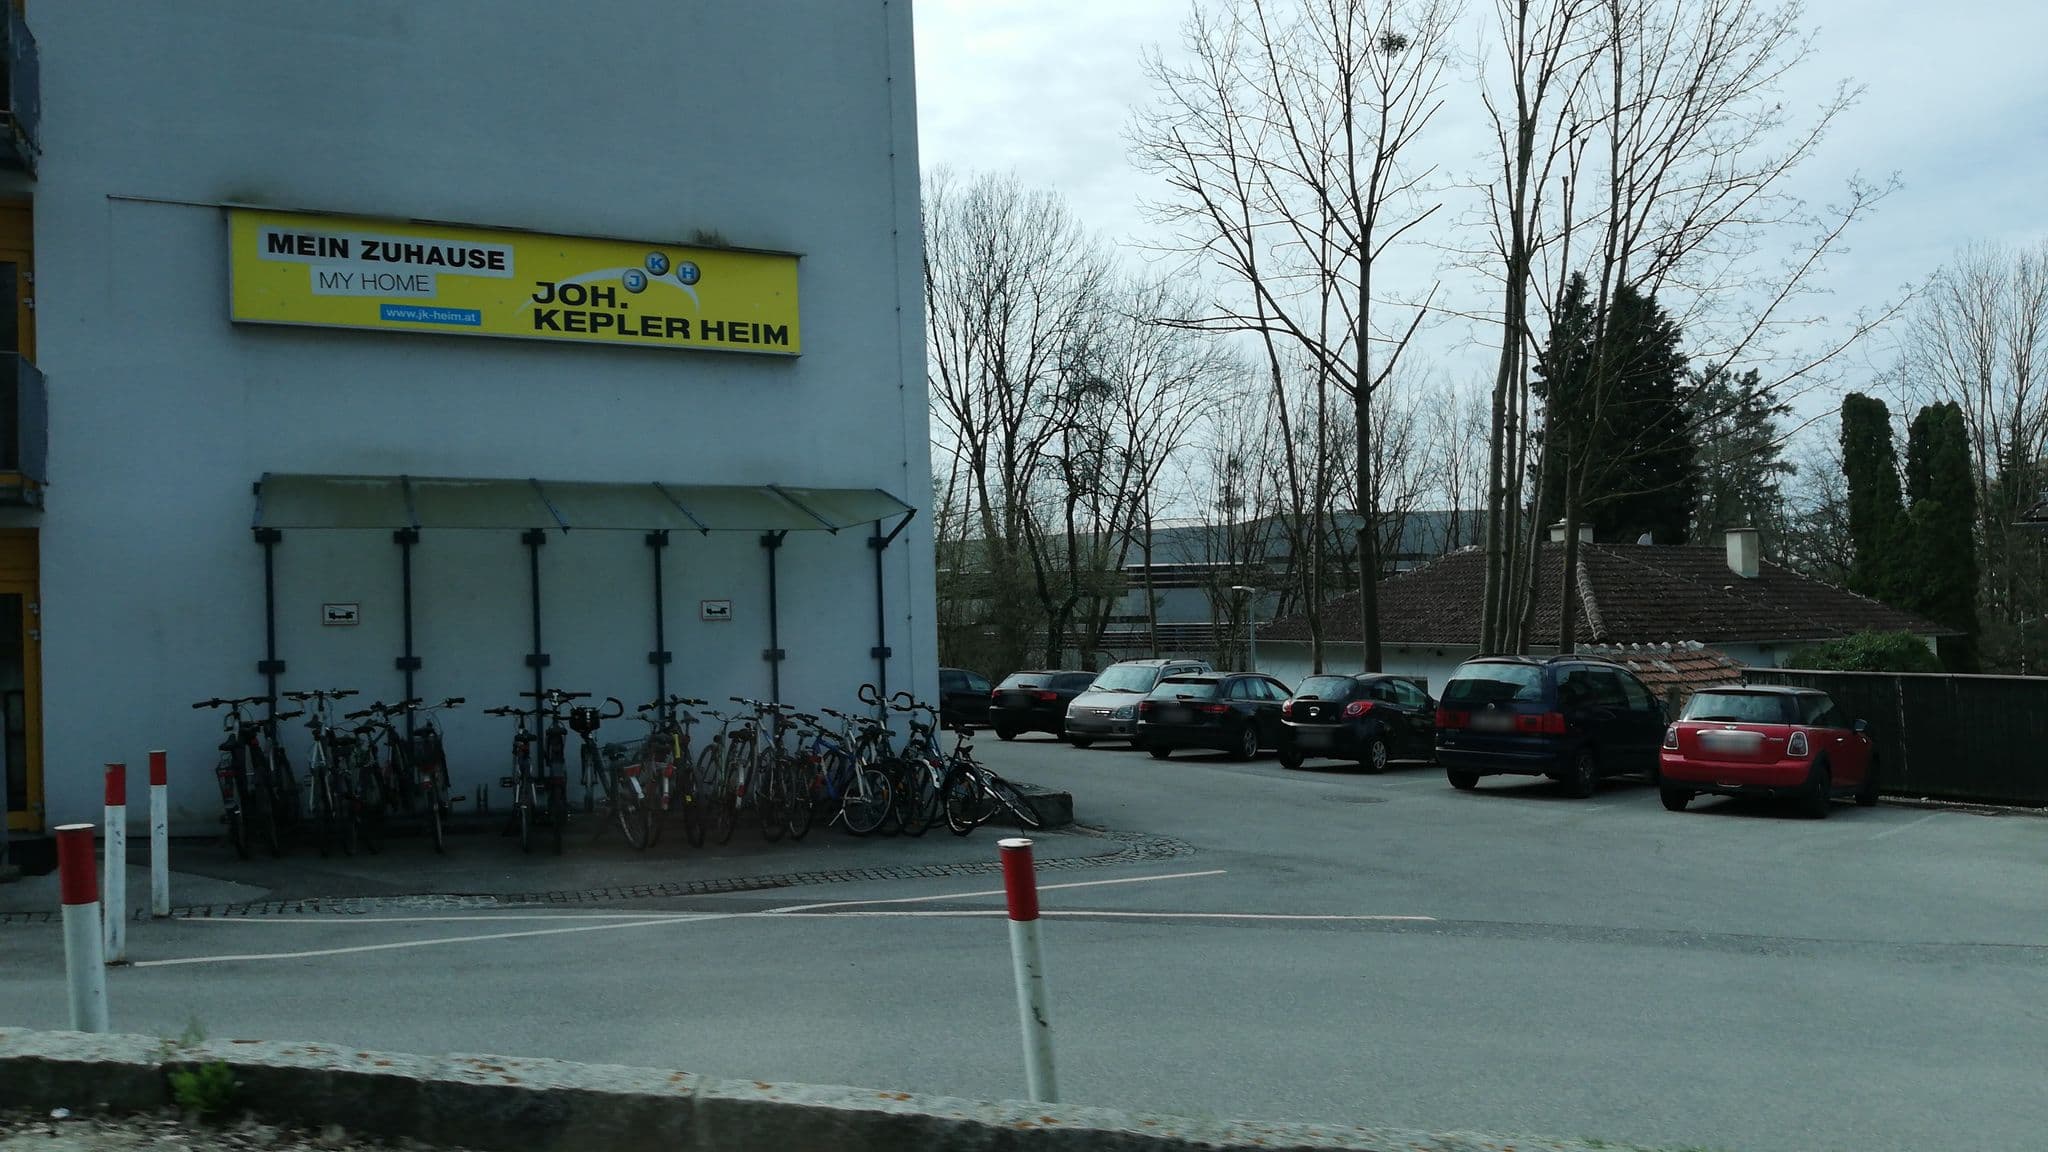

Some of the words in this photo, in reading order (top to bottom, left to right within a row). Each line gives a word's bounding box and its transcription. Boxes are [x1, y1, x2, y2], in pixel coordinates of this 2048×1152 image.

[268, 233, 349, 259] MEIN
[360, 240, 505, 270] ZUHAUSE
[319, 271, 354, 290] MY
[361, 273, 430, 292] HOME
[532, 281, 629, 309] JOH.
[385, 308, 477, 322] www.jk-heim.at
[533, 308, 691, 339] KEPLER
[701, 319, 789, 346] HEIM
